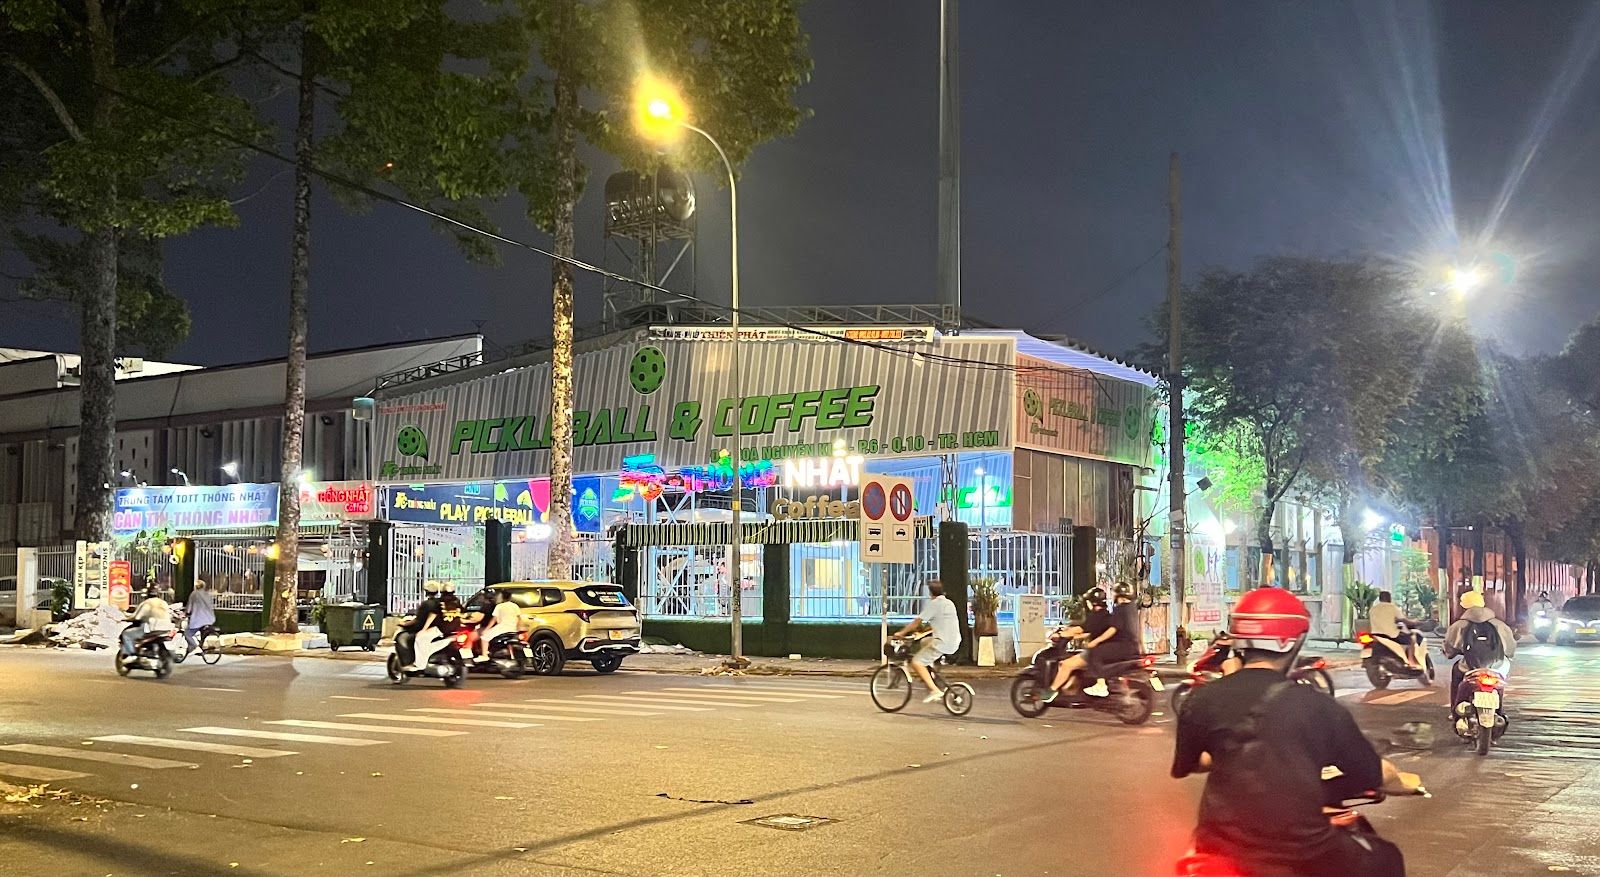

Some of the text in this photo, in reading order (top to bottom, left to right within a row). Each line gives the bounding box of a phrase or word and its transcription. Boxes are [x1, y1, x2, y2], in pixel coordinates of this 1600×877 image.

[737, 329, 766, 339] PHÁT
[669, 401, 703, 442] &
[712, 385, 881, 437] COFFEE
[858, 439, 879, 454] P.6
[892, 435, 925, 453] Q.10
[963, 431, 999, 447] HCM
[119, 495, 150, 506] TRUNG
[153, 493, 173, 504] TÂM
[771, 495, 861, 520] Coffee
[440, 503, 471, 522] PLAY
